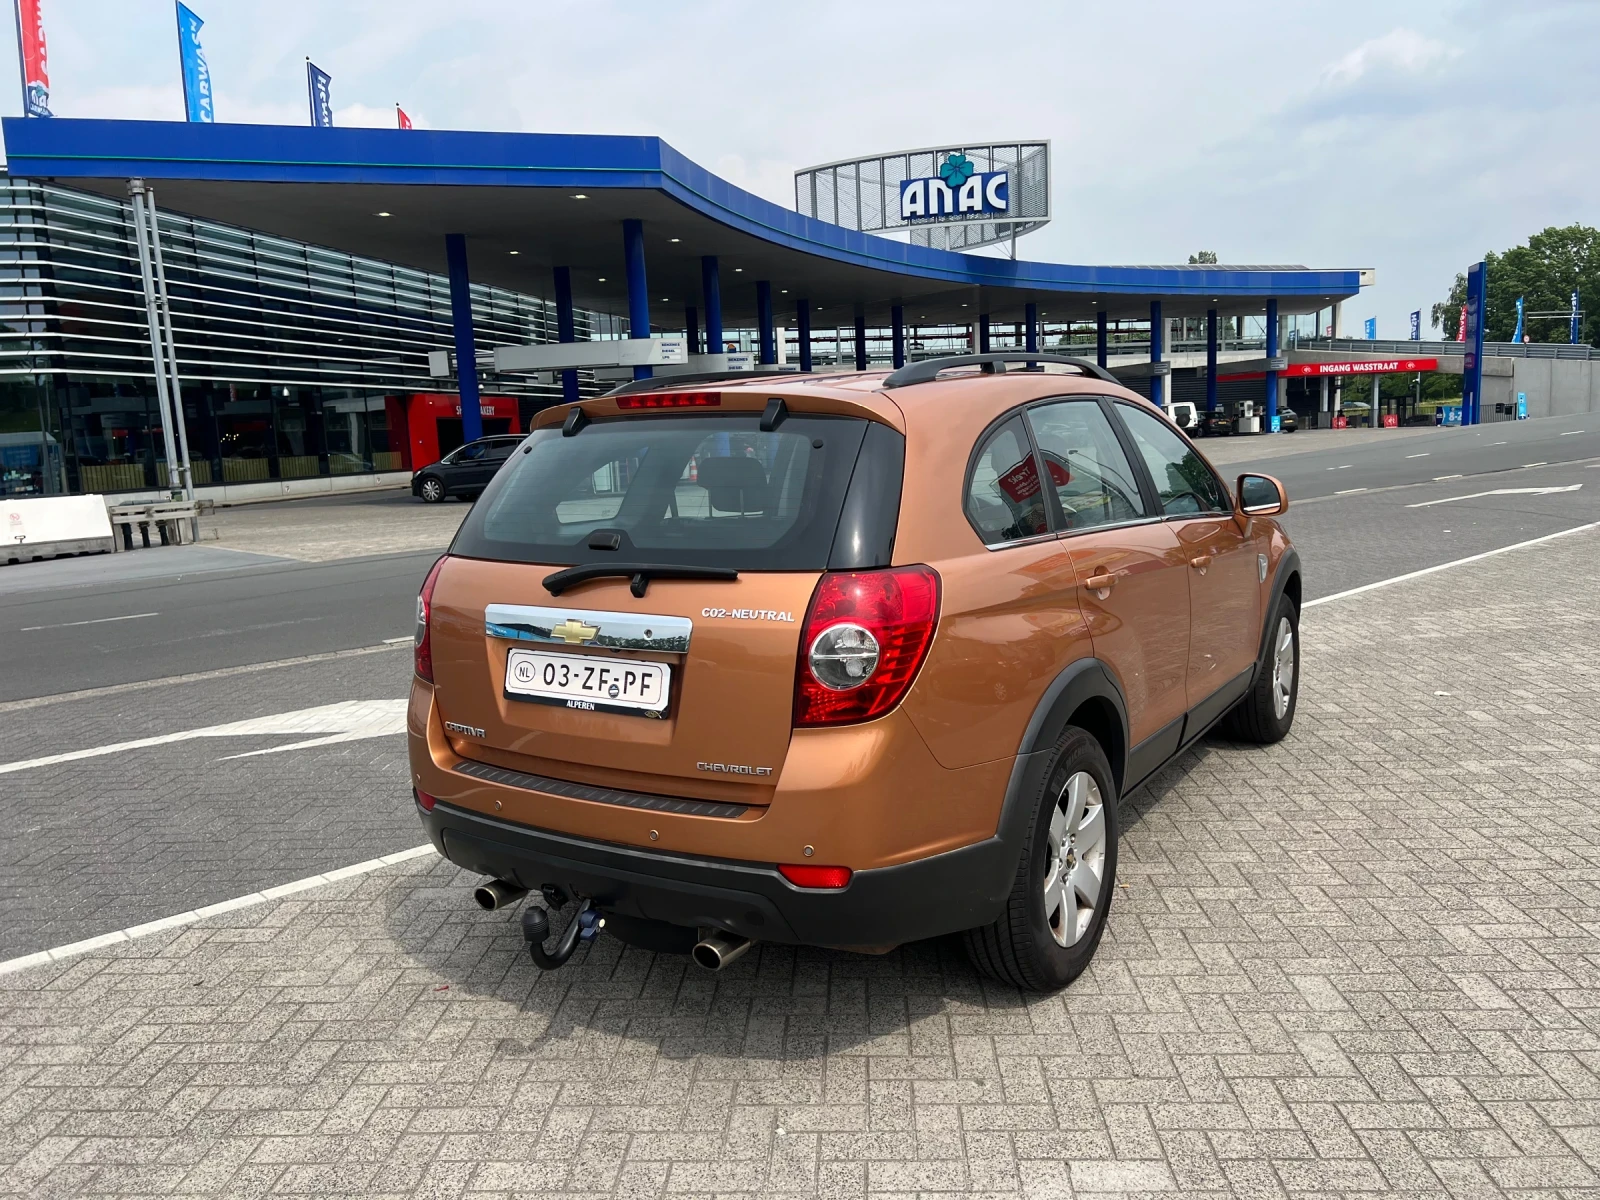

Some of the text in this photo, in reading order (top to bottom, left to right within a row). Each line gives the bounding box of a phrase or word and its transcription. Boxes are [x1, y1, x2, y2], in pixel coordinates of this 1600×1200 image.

[902, 173, 1007, 217] ANAC
[1319, 362, 1399, 373] INGANG WASSTRAAT
[519, 663, 653, 697] NL 03-ZF-PF
[566, 700, 595, 711] ALPEREN
[444, 721, 486, 738] CAPTIVA
[696, 761, 773, 777] CHEVROLET
